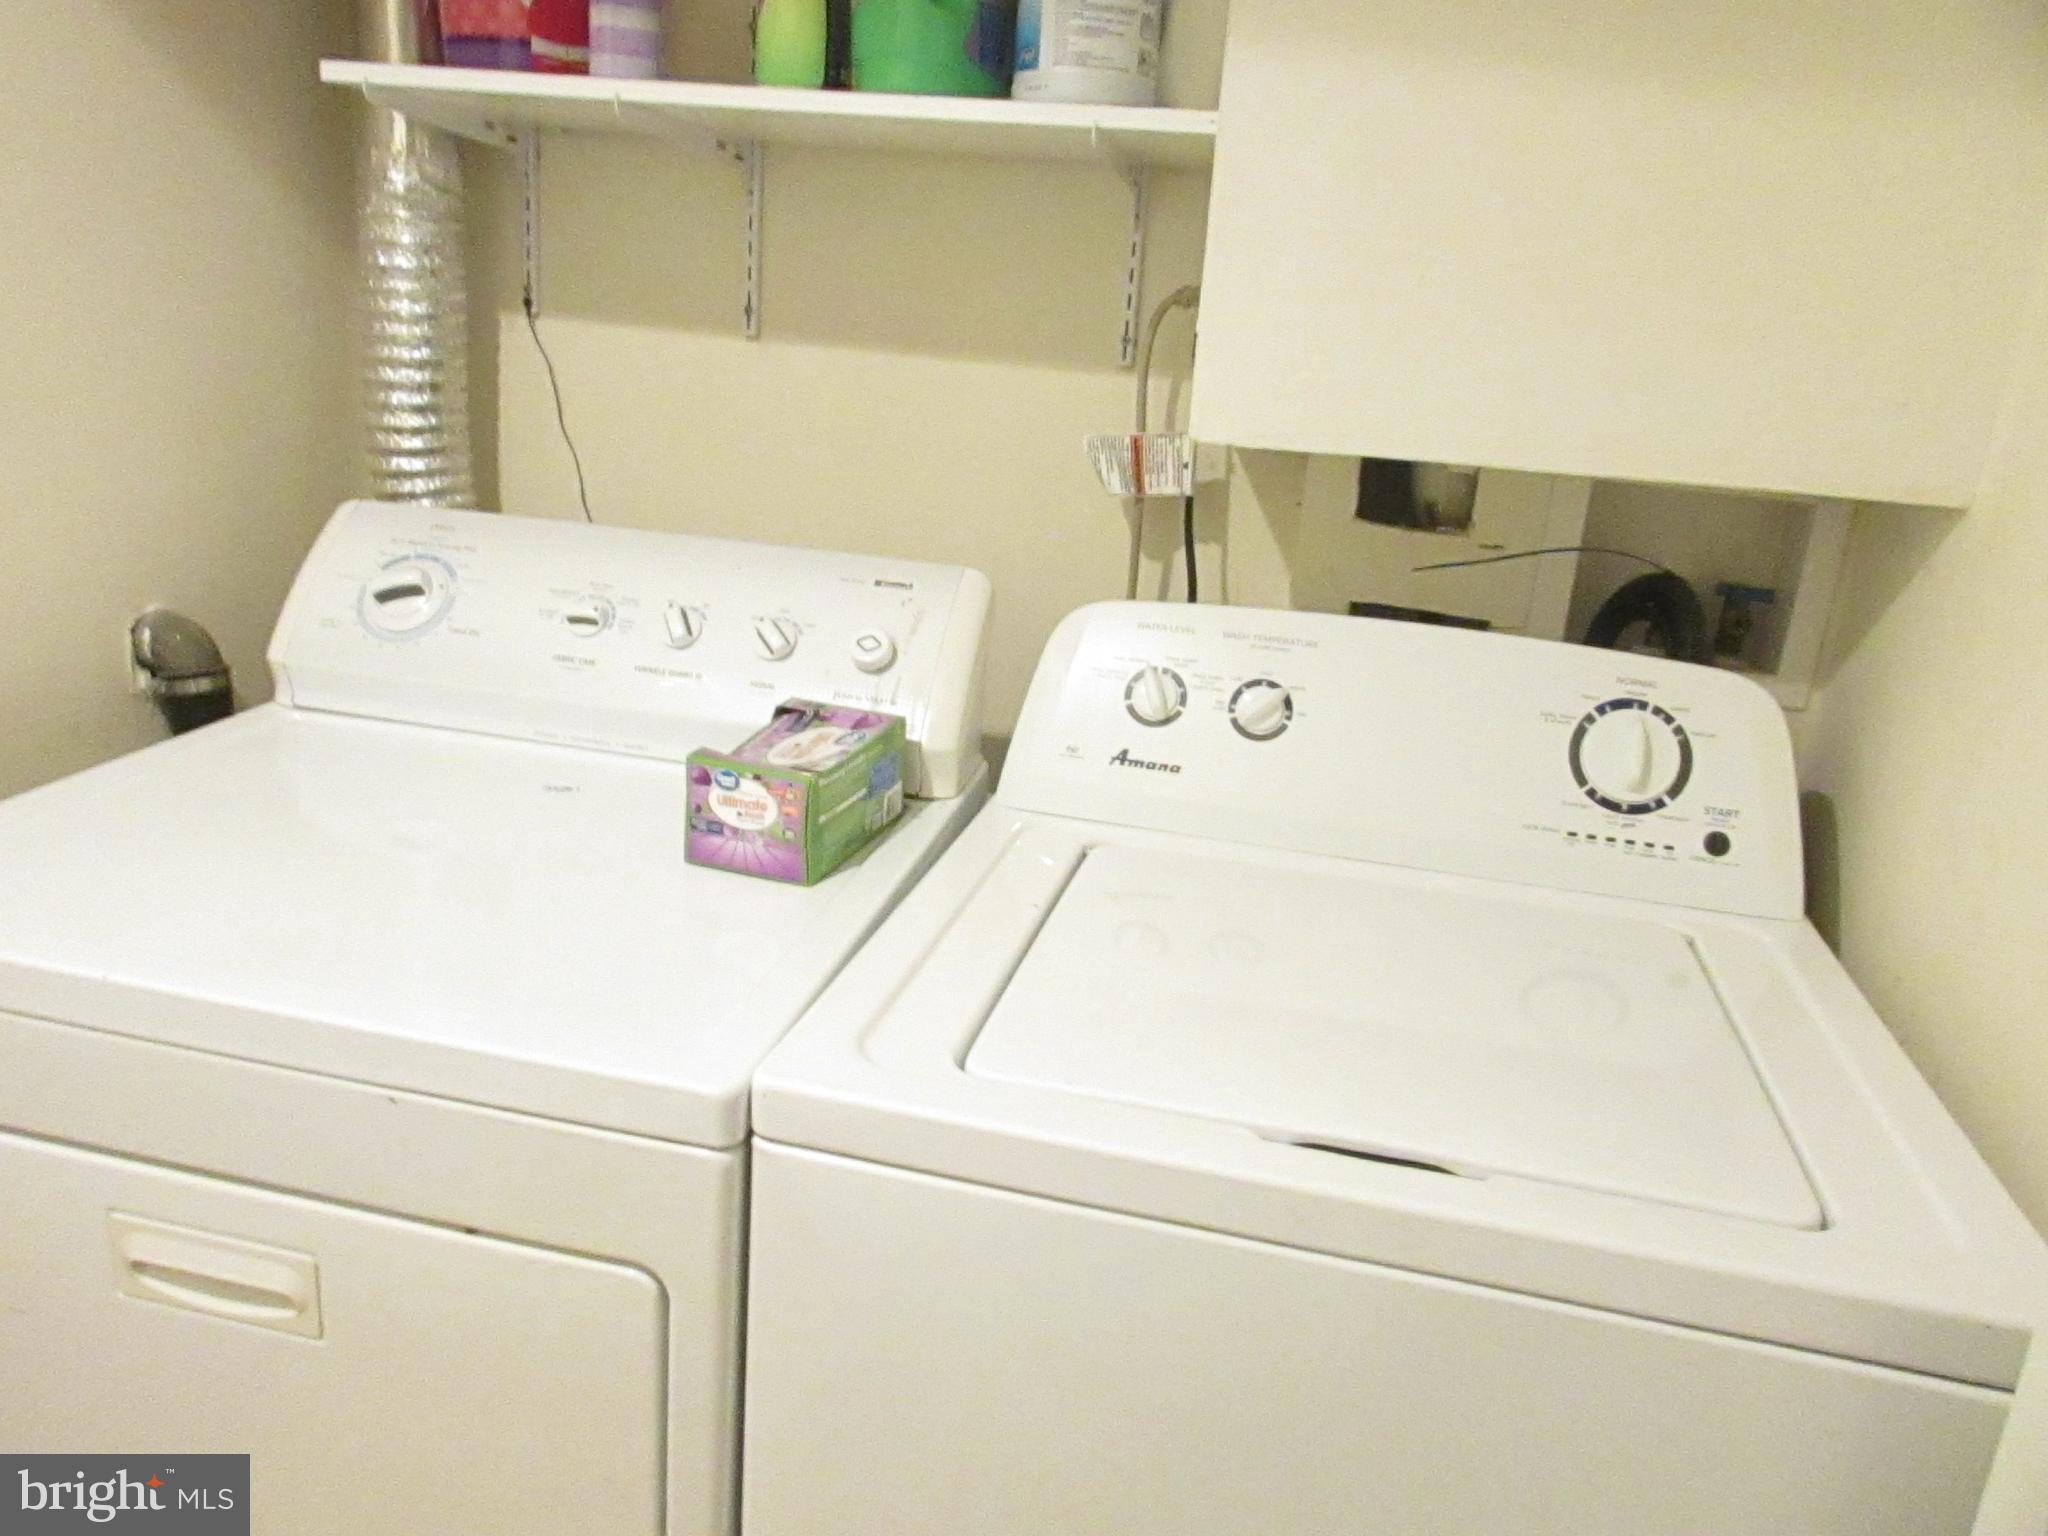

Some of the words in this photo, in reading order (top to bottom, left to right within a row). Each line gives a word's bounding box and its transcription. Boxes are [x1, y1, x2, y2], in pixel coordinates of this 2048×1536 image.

[1137, 622, 1168, 633] WATER
[1168, 625, 1196, 635] LEVEL
[1222, 631, 1249, 641] WASH
[1252, 633, 1319, 649] TEMPERATURE
[1615, 676, 1658, 689] NORMAL
[1108, 748, 1182, 774] Amana
[716, 794, 769, 812] Ultimate
[1703, 806, 1741, 818] START
